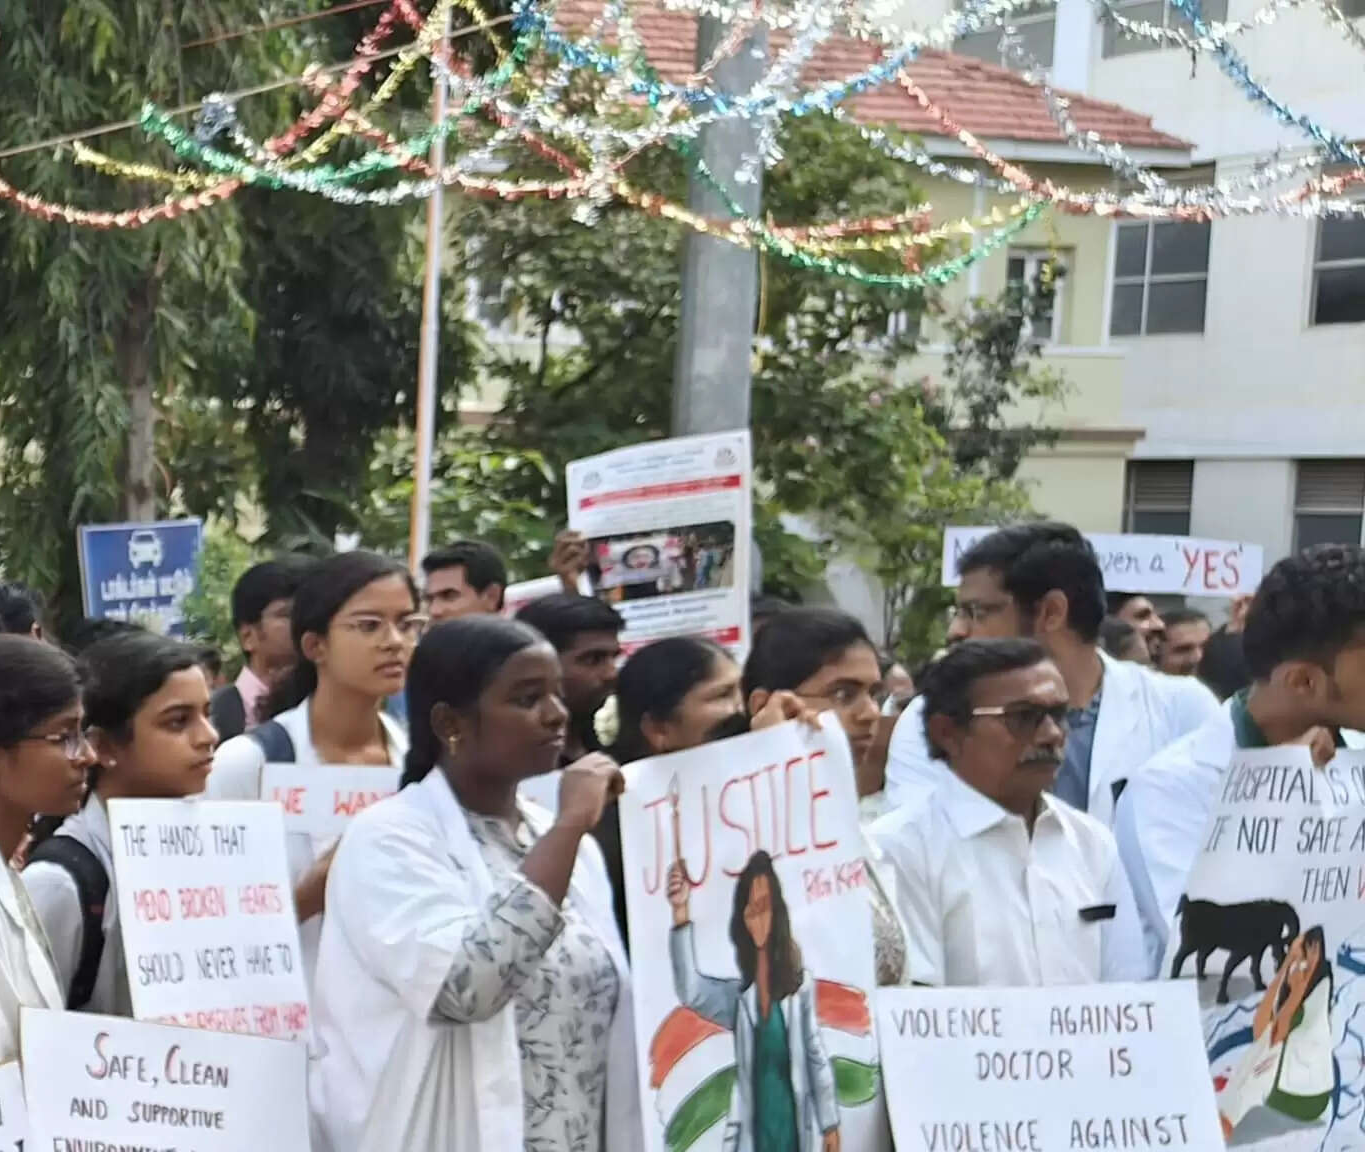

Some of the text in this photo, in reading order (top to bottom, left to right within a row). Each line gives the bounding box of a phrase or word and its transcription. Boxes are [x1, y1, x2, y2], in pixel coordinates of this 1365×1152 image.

[1221, 762, 1322, 806] HOSPITAL
[119, 824, 248, 858] THE HANDS THAT
[642, 748, 839, 896] JUSTICE
[1236, 814, 1283, 855] NOT
[1296, 814, 1349, 855] SAFE
[1302, 865, 1352, 904] THEN
[195, 945, 239, 980] NEVER
[891, 1002, 1156, 1039] VIOLENCE AGAINST
[975, 1046, 1133, 1082] DOCTOR IS
[69, 1097, 225, 1129] AND SUPPORTIVE
[920, 1113, 1188, 1152] VIOLENCE AGAINST
